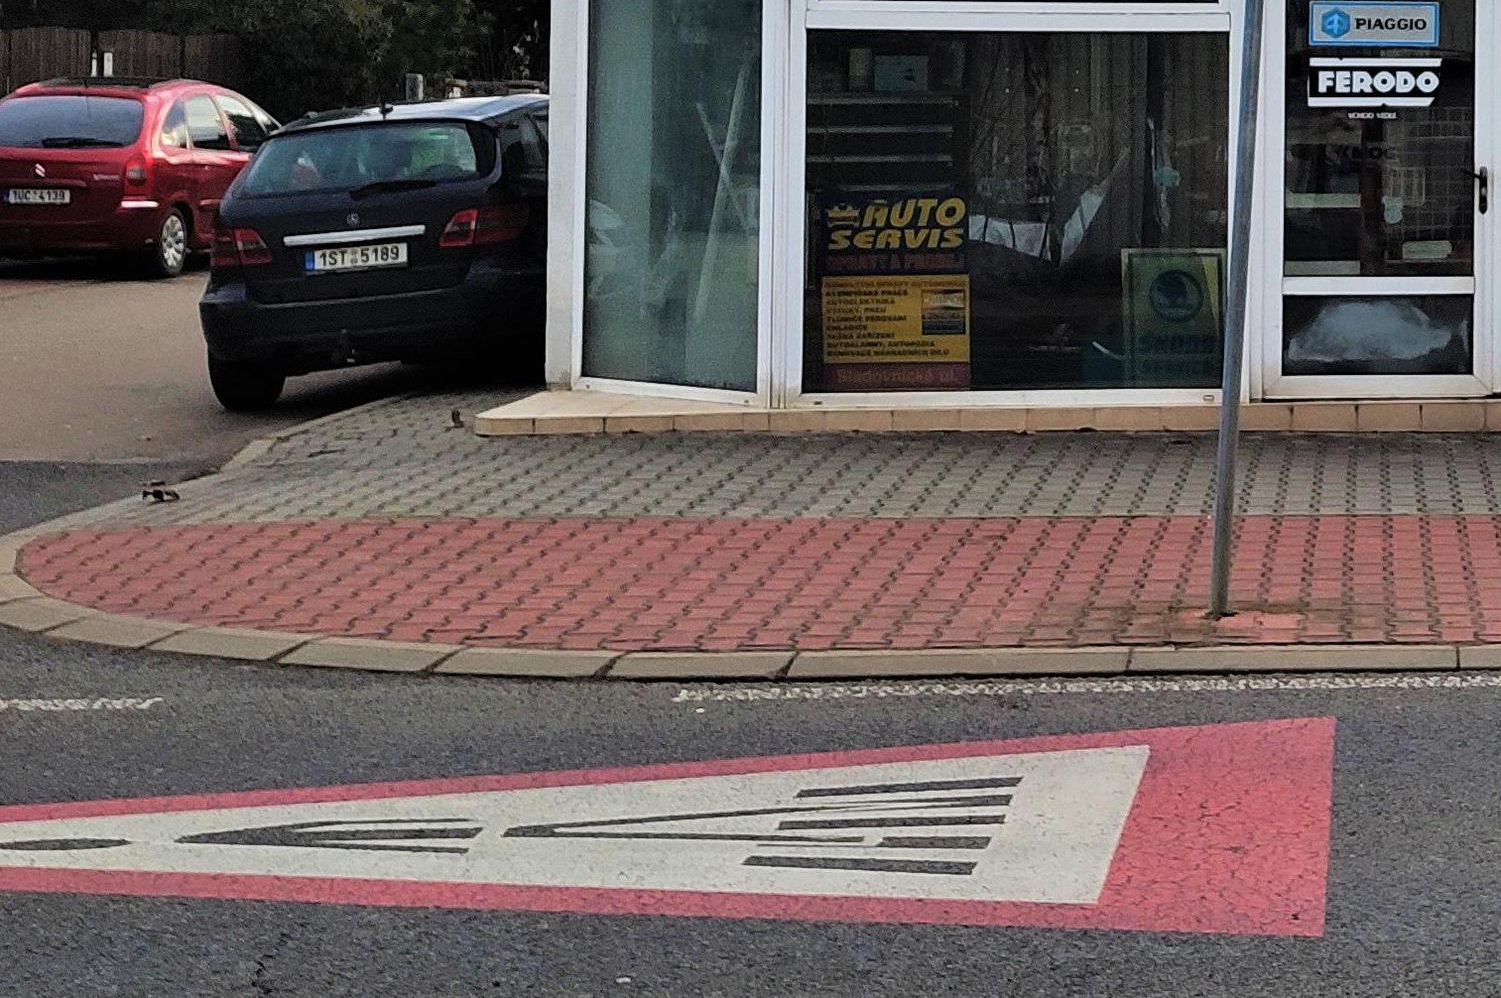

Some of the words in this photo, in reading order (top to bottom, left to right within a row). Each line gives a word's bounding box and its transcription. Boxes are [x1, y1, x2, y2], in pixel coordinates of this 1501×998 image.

[1355, 18, 1427, 31] PIAGGIO
[1317, 70, 1440, 94] FERODO
[862, 197, 966, 228] AUTO
[828, 228, 964, 250] SERVIS
[320, 248, 348, 267] 1ST
[360, 245, 400, 263] 5189
